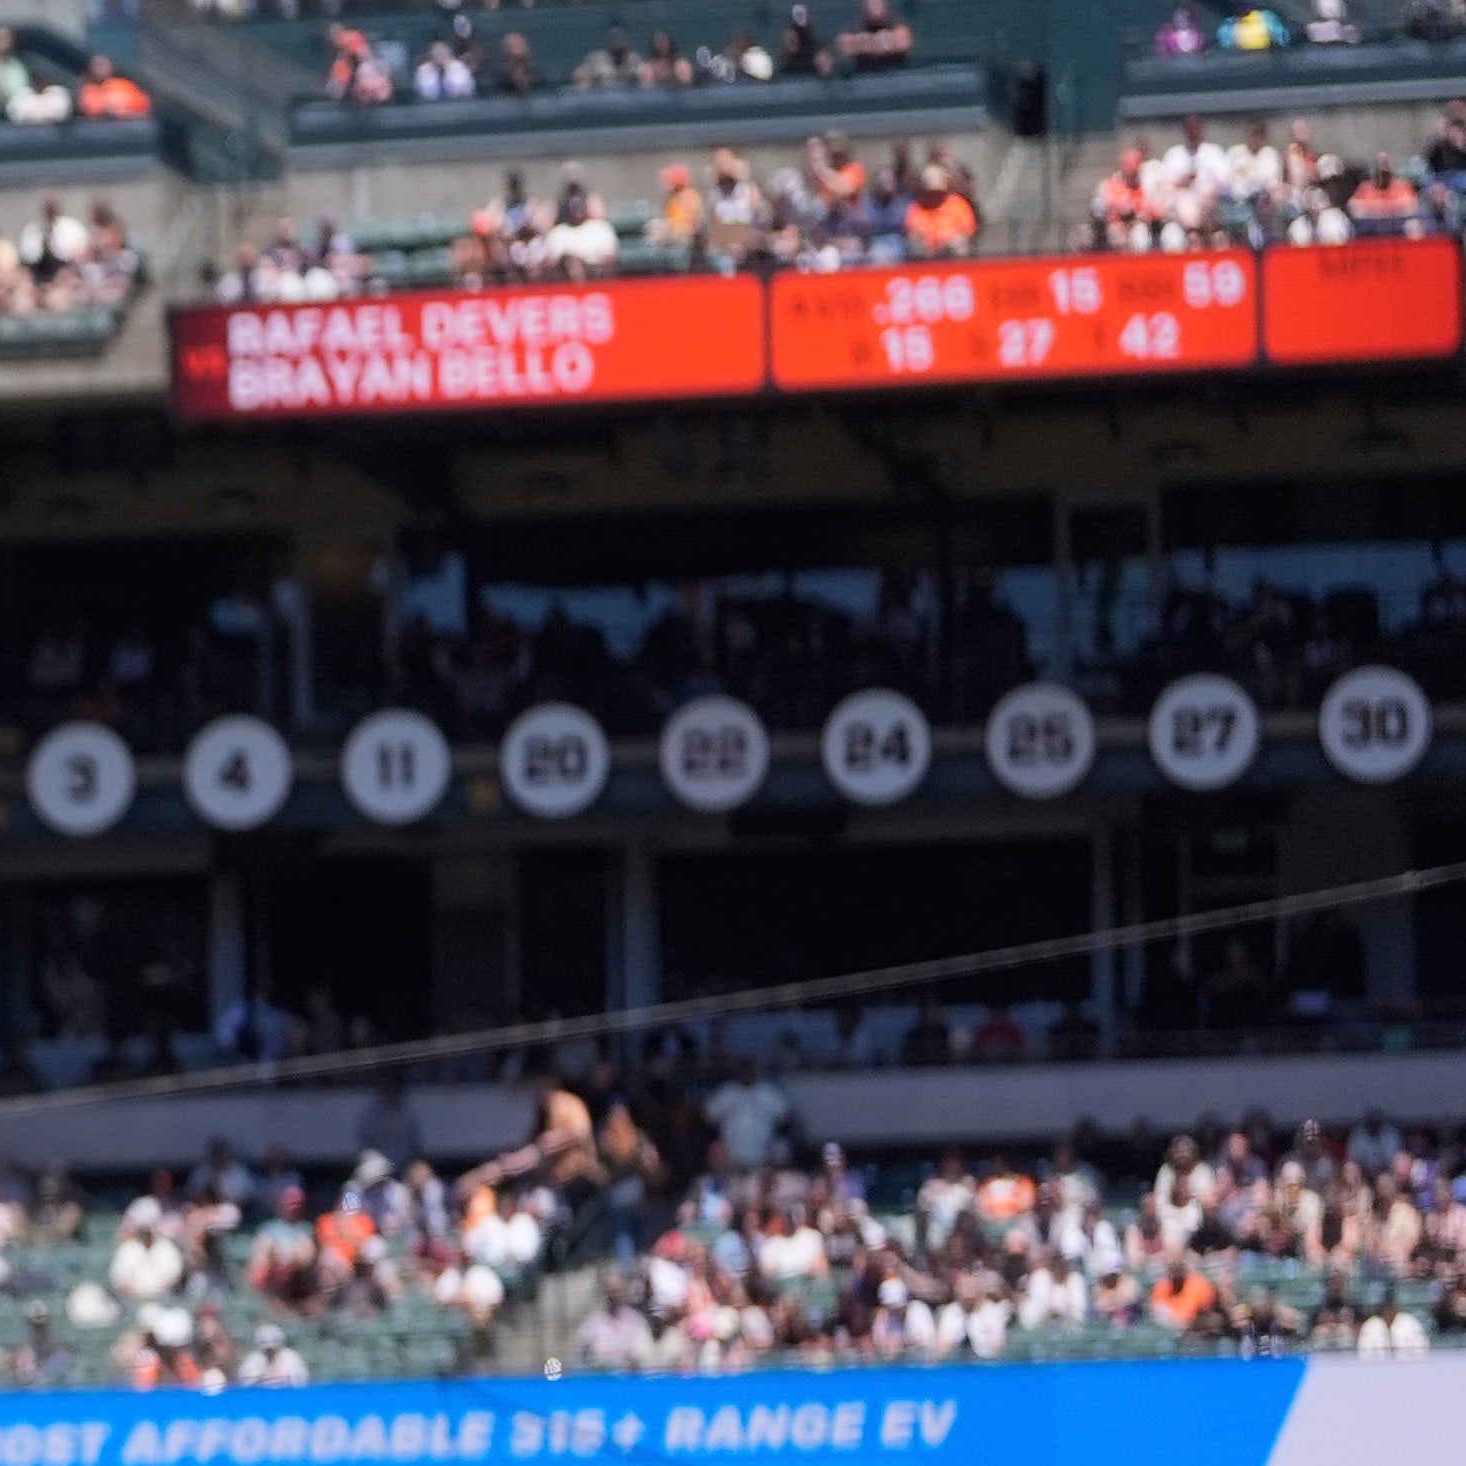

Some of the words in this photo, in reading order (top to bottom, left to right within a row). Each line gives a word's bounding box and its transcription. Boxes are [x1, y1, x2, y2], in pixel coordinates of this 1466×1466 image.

[1049, 266, 1102, 314] 15
[228, 304, 411, 356] RAFAEL
[421, 292, 614, 352] DEVERS
[881, 325, 934, 372] 15
[998, 318, 1055, 366] 27
[1119, 311, 1181, 360] 42
[228, 352, 433, 411] BRAYAN
[437, 341, 594, 398] BELLO
[844, 720, 912, 774] 24
[1006, 712, 1075, 766] 25
[1171, 703, 1238, 757] 27
[1341, 698, 1412, 753] 30
[66, 752, 101, 801] 3
[216, 746, 253, 794] 4
[378, 740, 415, 792] 11
[522, 733, 591, 788] 20
[680, 725, 750, 781] 22
[121, 1410, 495, 1466] AFFORDABLE
[666, 1400, 866, 1452] RANGE
[879, 1399, 957, 1450] EV
